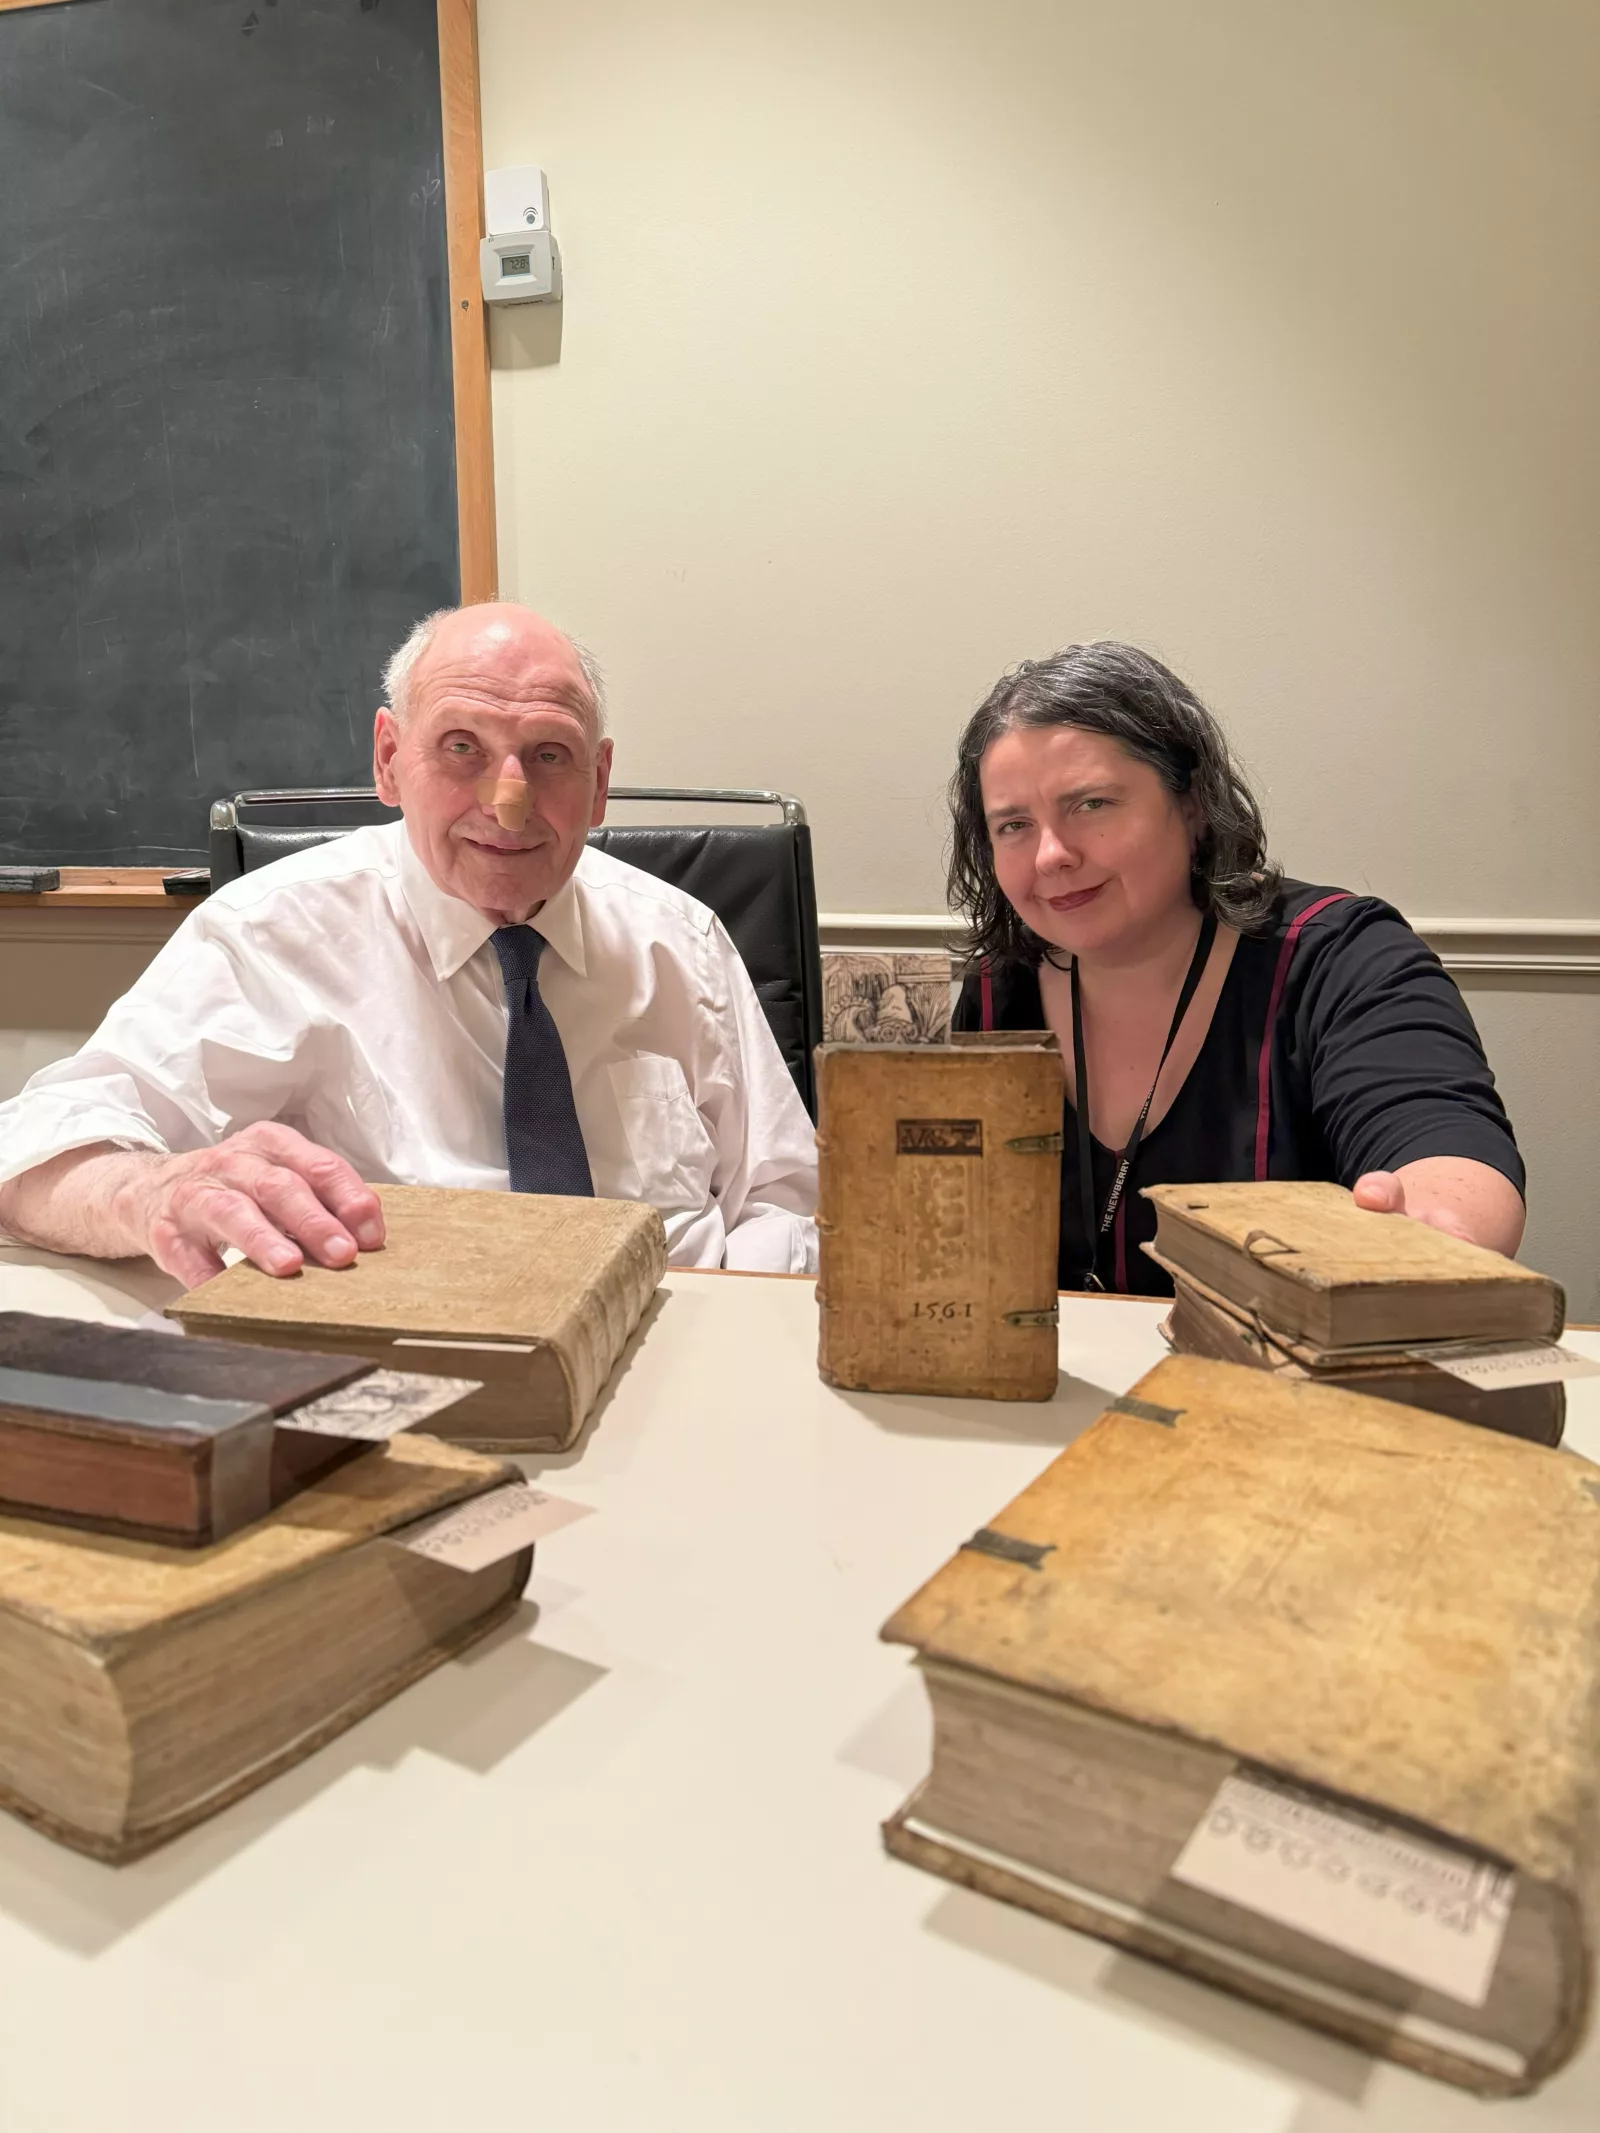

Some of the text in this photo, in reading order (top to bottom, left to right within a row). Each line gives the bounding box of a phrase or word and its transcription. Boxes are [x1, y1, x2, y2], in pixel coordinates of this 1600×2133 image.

[1101, 1159, 1130, 1232] THE NEWBERRY
[914, 1301, 971, 1320] 1561
